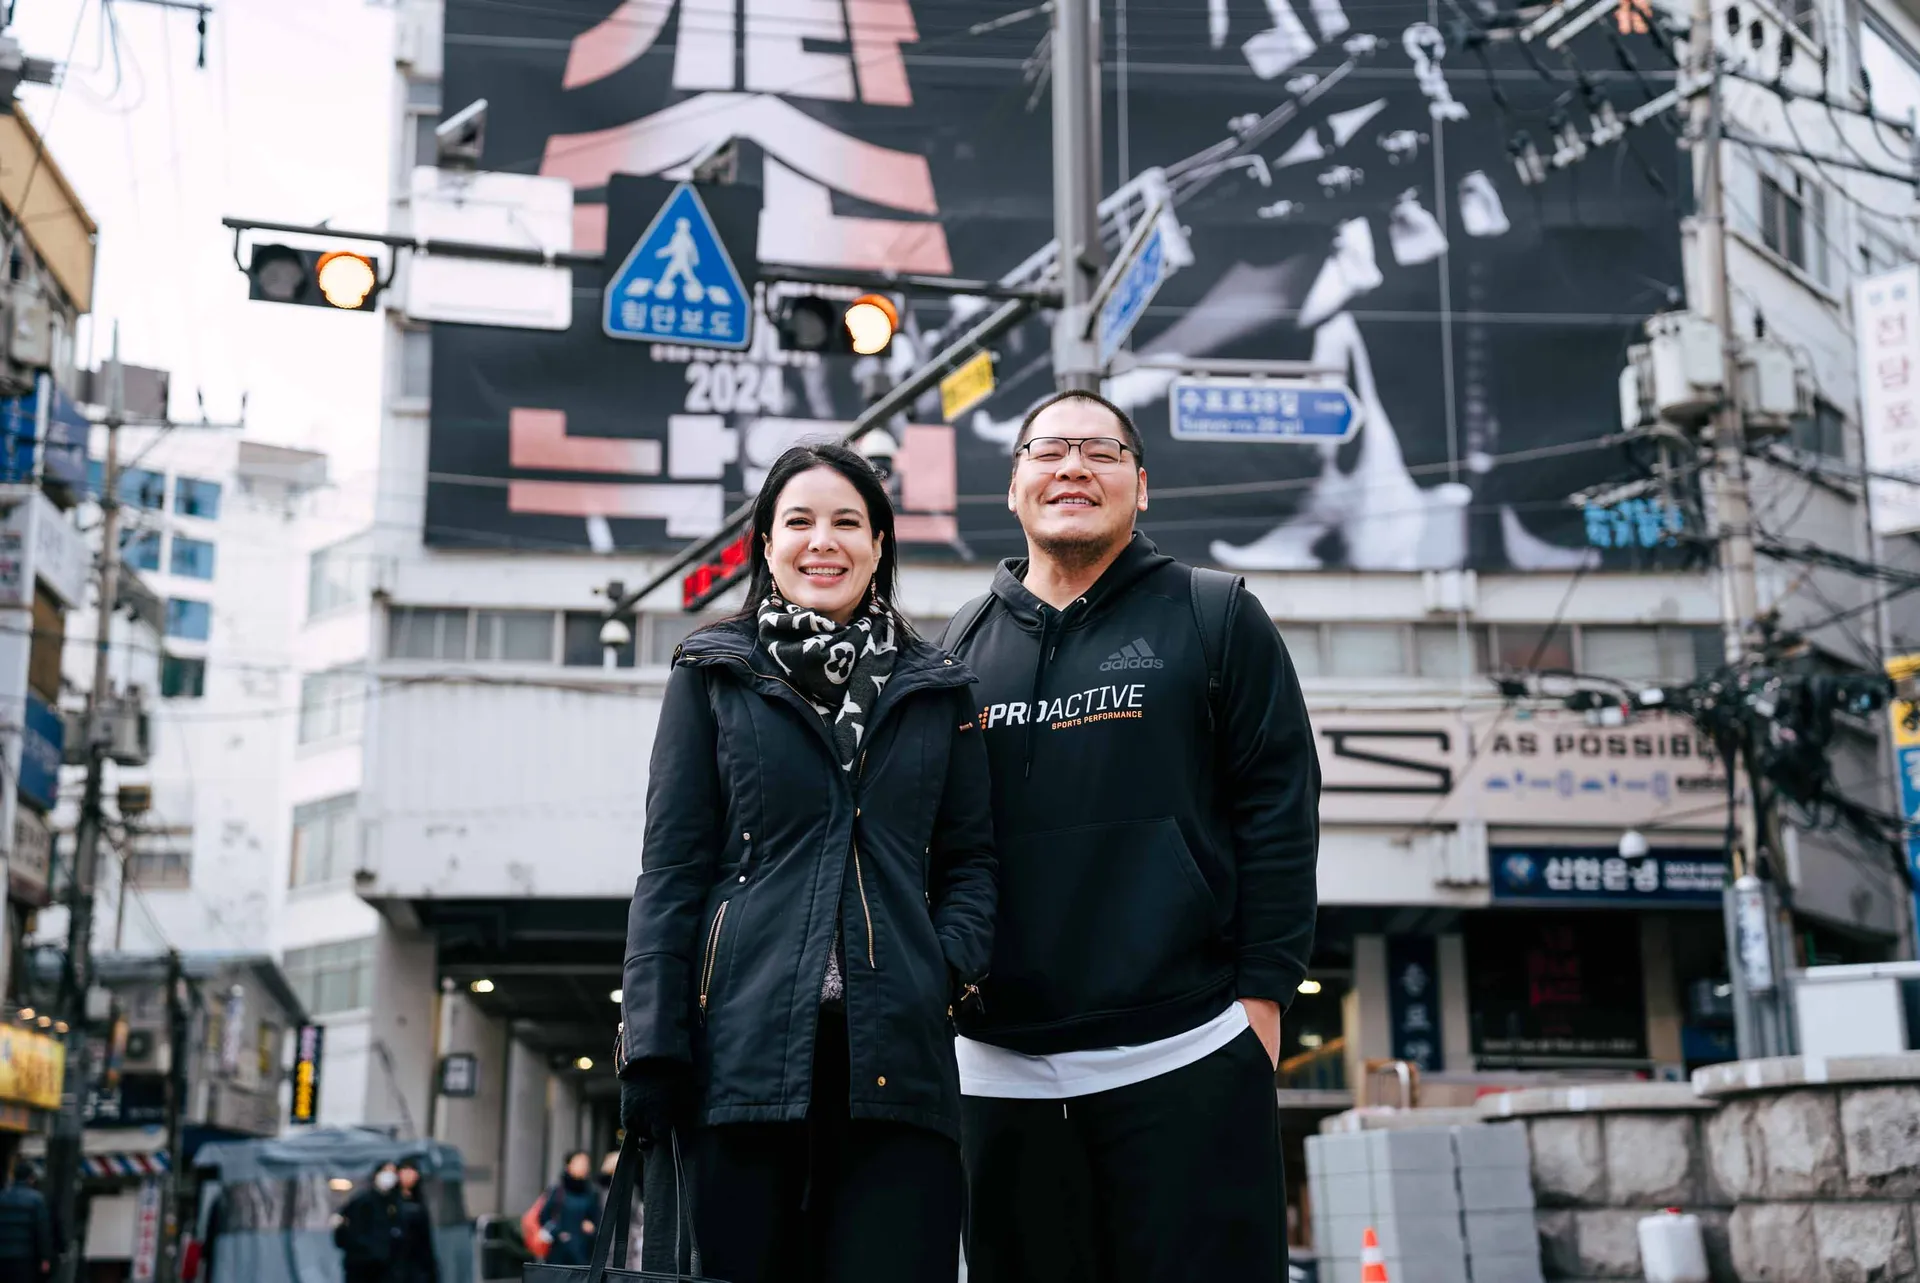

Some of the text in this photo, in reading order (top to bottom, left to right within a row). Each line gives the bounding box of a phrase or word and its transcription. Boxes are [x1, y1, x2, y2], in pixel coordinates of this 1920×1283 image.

[620, 300, 733, 337] 횡단보도
[684, 361, 785, 415] 2024
[1099, 656, 1164, 671] adidas
[987, 684, 1146, 729] PROACTIVE
[1051, 710, 1143, 730] SPORTS PERFORMANCE
[1492, 733, 1720, 758] AS POSSIBL
